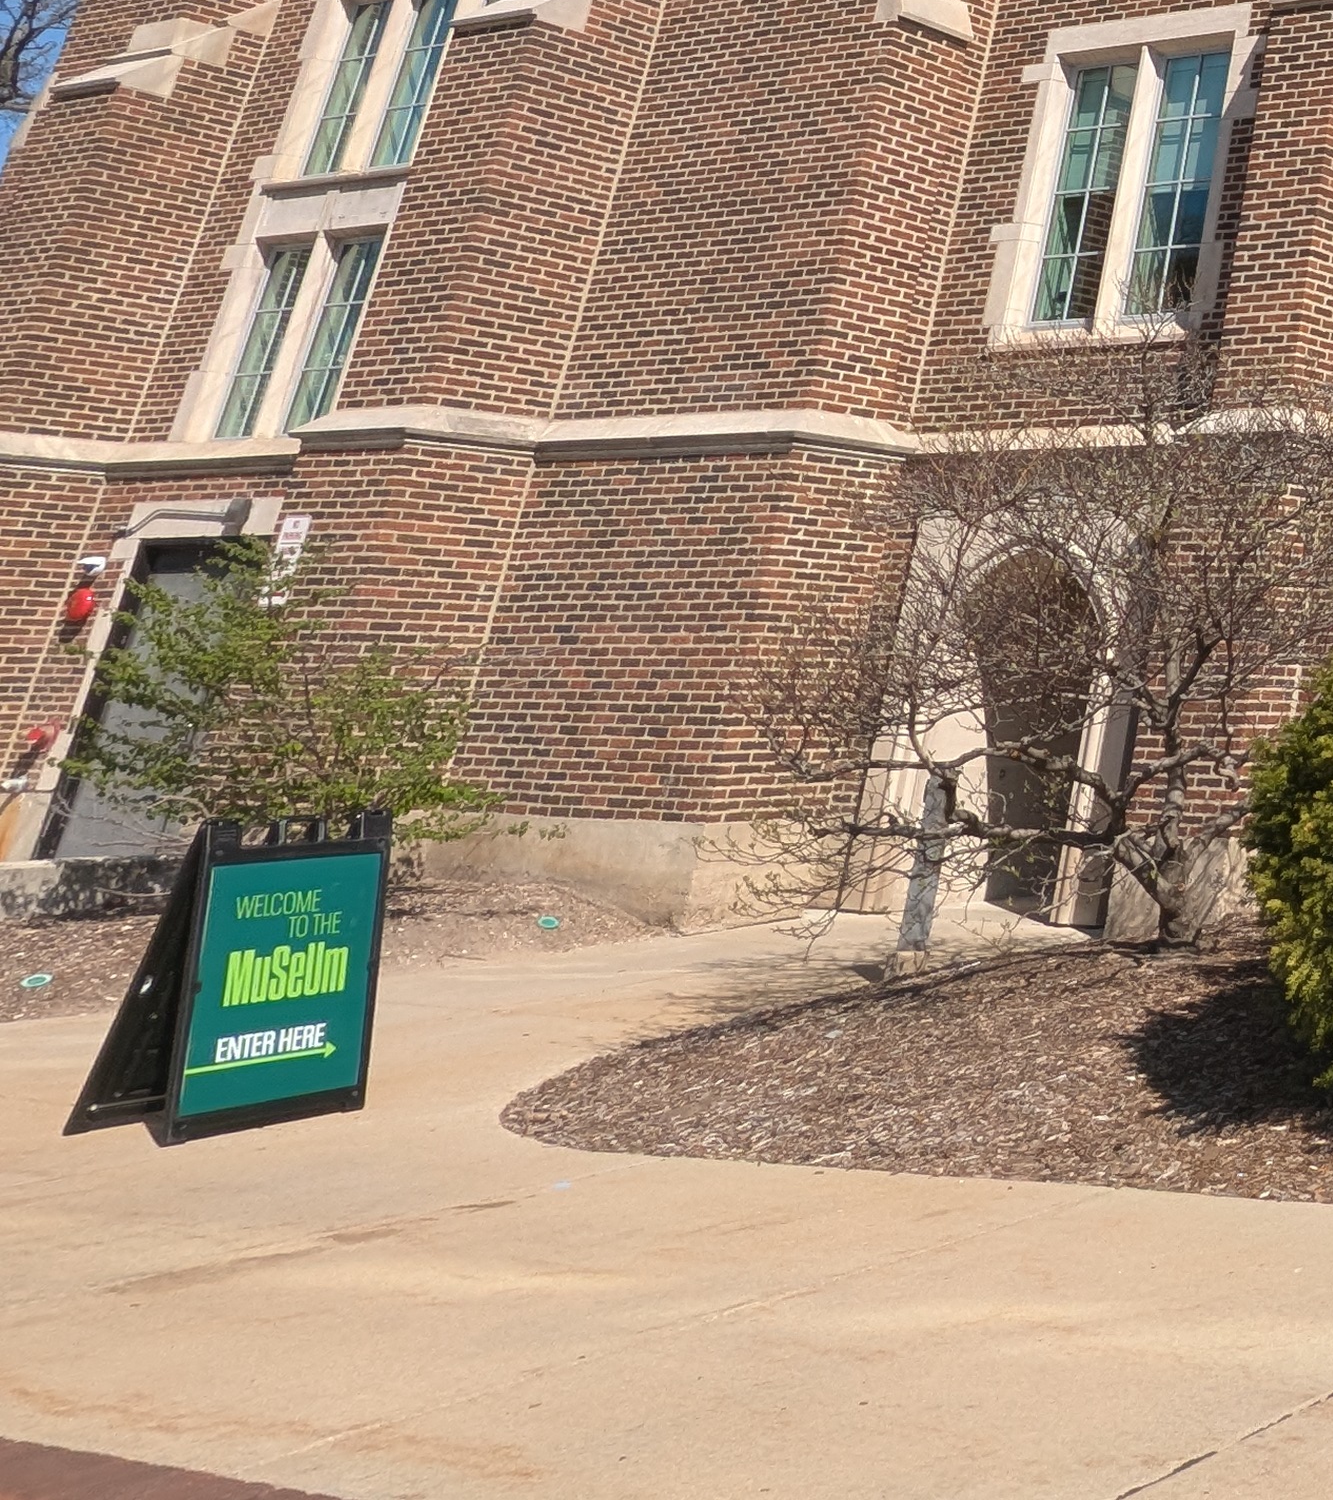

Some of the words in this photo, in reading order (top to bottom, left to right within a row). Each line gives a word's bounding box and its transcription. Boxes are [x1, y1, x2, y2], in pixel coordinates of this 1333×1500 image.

[235, 889, 322, 919] WELCOME
[289, 914, 309, 938] TO
[313, 911, 343, 936] THE
[222, 941, 349, 1007] MuSeUm
[214, 1030, 277, 1063] ENTER
[278, 1022, 327, 1053] HERE
